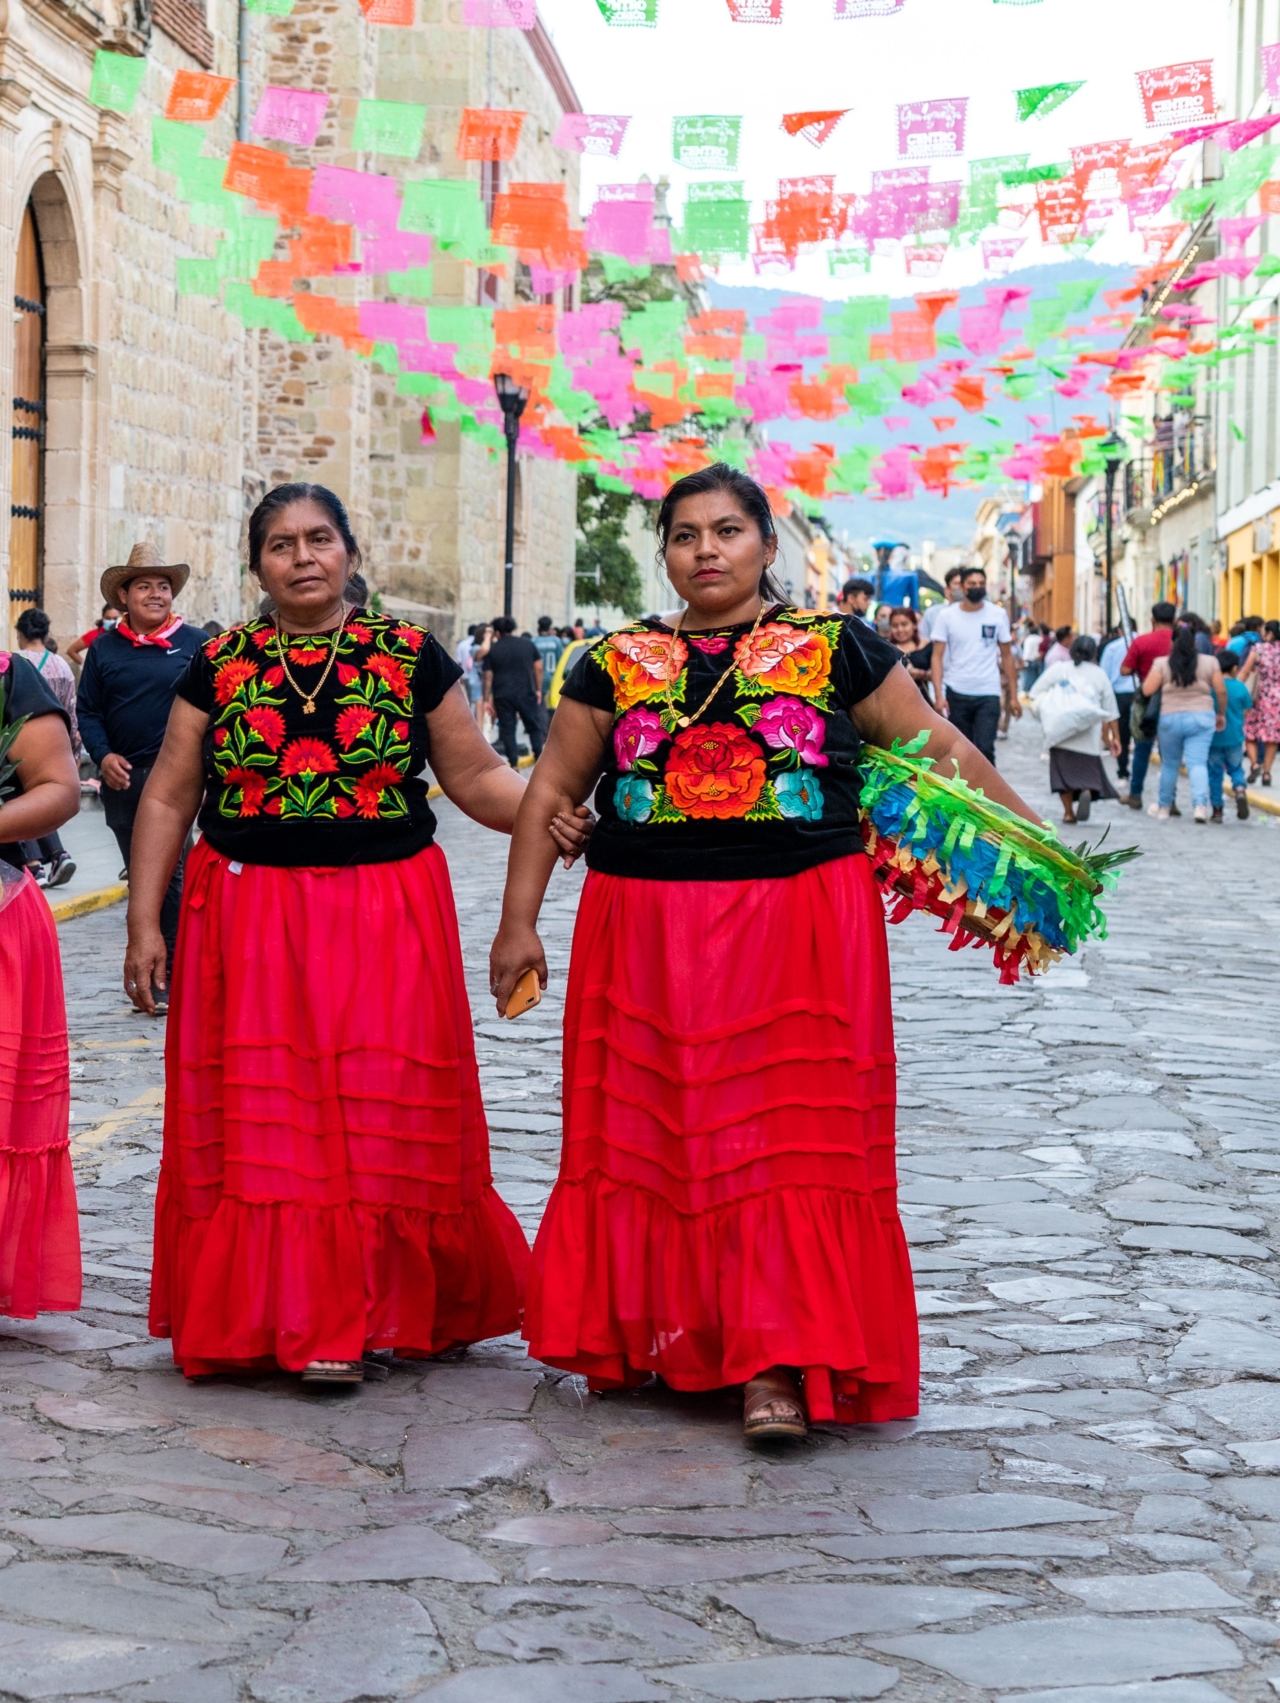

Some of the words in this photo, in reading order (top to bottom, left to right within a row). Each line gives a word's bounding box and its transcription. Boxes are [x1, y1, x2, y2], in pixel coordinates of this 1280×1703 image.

[1151, 95, 1204, 113] CENTRO
[906, 131, 957, 145] CENTRO
[679, 145, 729, 158] CENTRO
